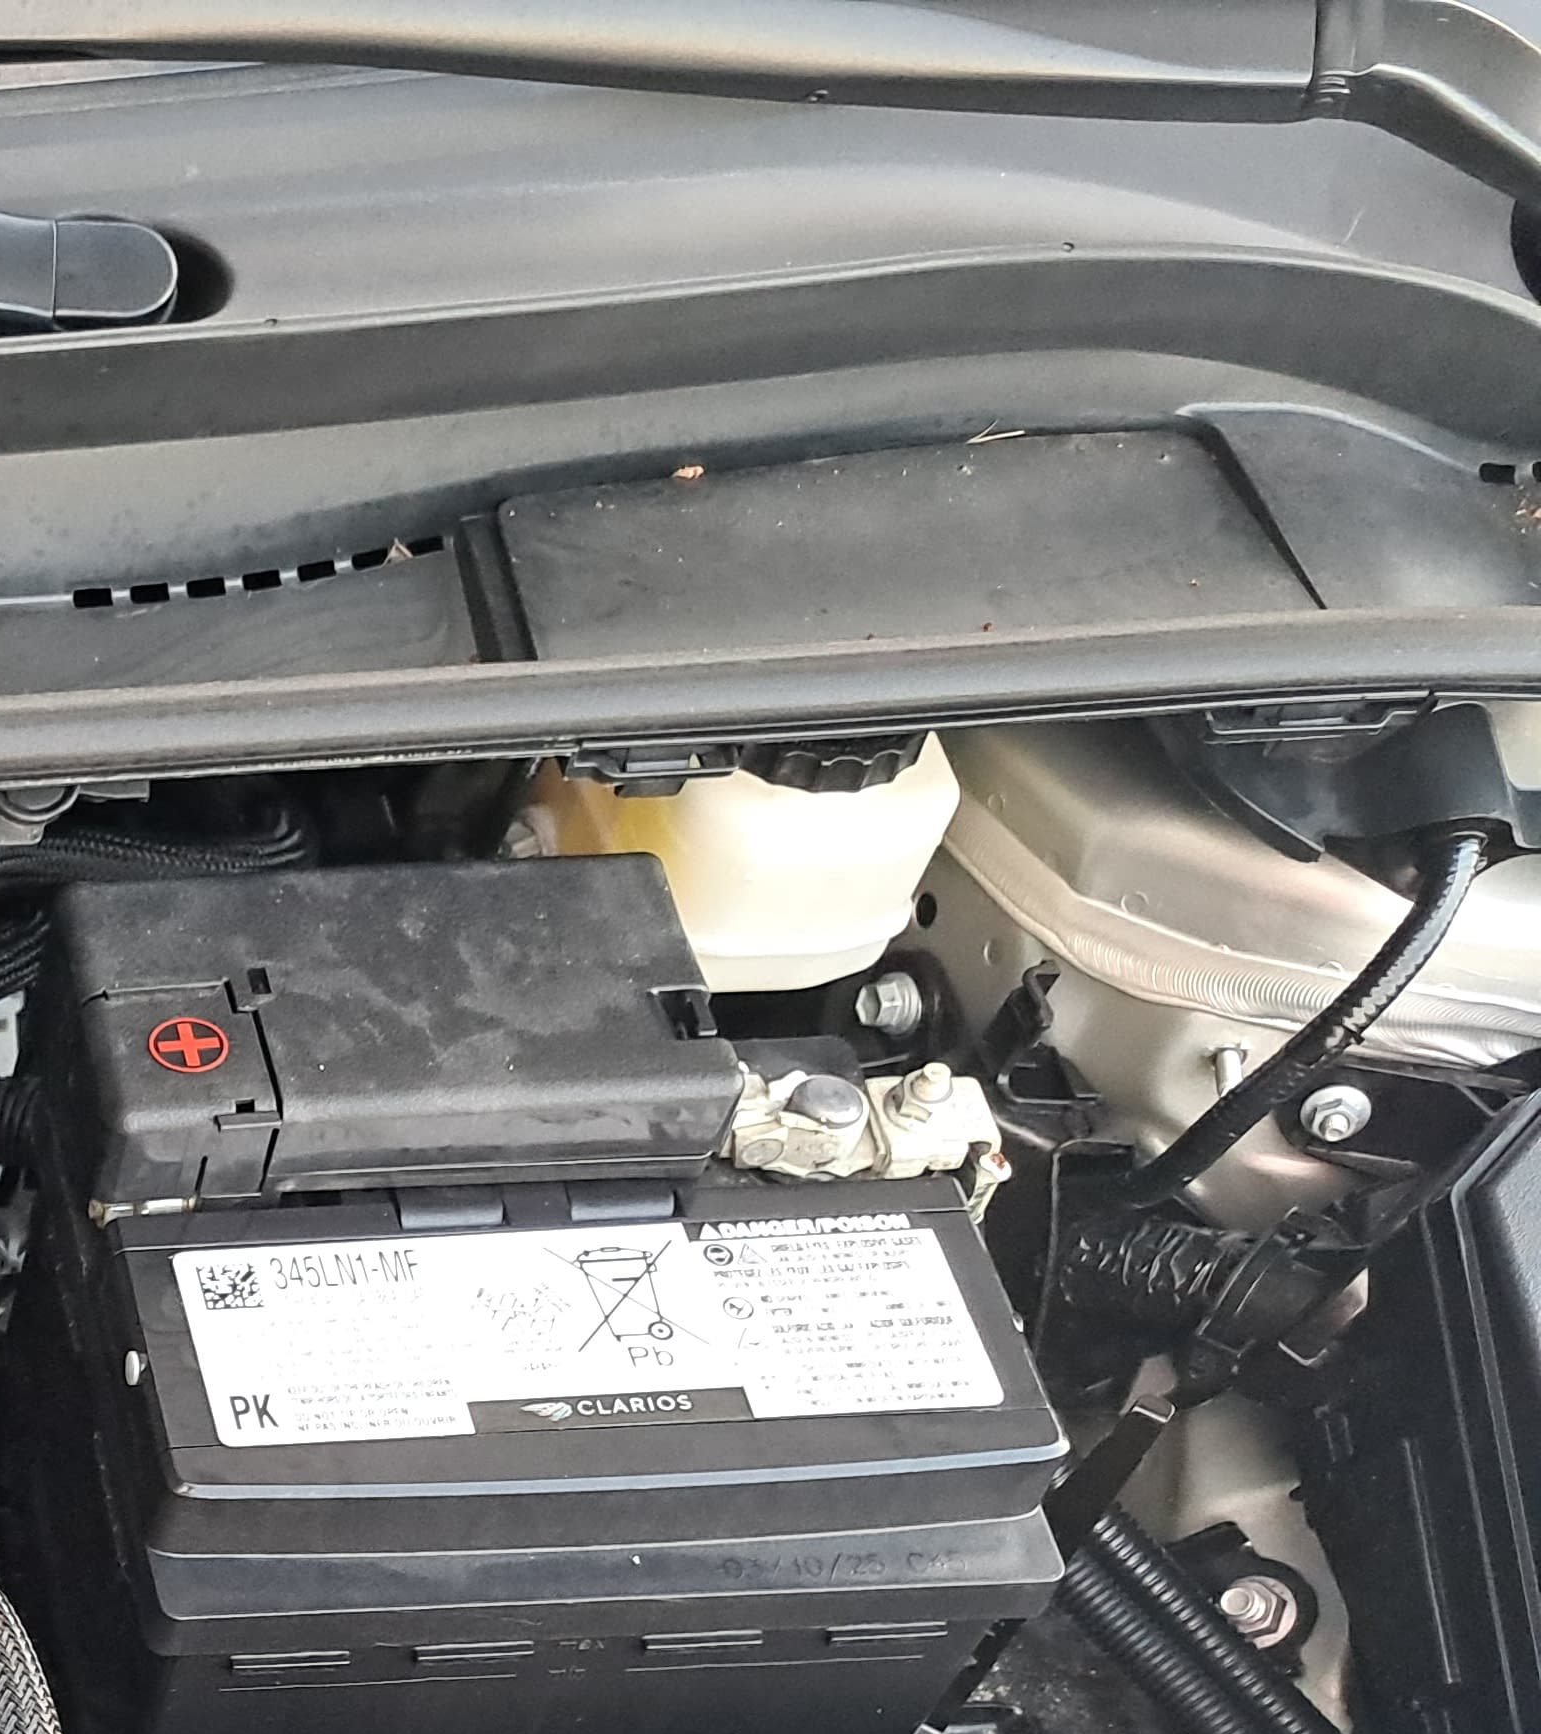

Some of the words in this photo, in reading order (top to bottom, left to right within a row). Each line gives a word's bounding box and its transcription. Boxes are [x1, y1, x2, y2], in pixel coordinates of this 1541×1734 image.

[719, 1213, 911, 1239] DANGER/POISON
[270, 1249, 419, 1290] 345LN1-MF
[628, 1346, 674, 1367] Pb
[229, 1394, 279, 1430] PK
[575, 1394, 694, 1416] CLARIOS
